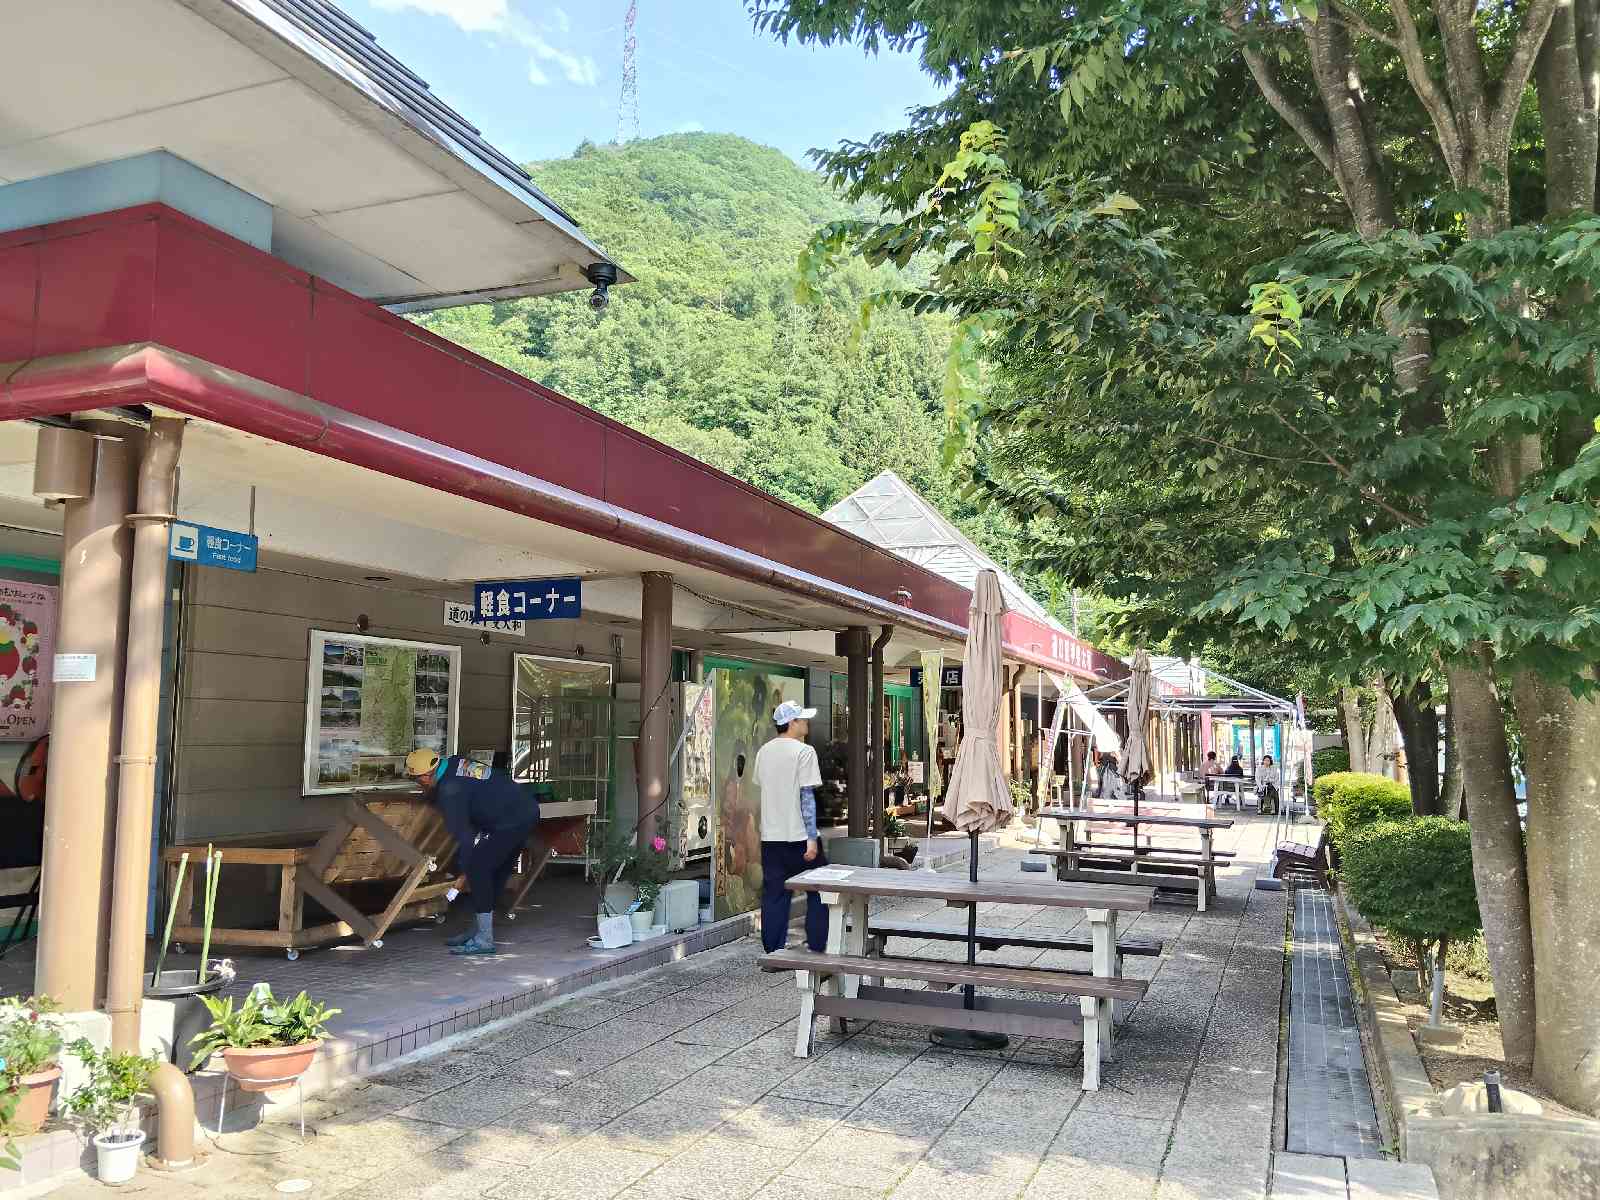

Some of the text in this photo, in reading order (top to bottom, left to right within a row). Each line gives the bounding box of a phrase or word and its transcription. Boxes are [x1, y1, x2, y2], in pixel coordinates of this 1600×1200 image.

[480, 587, 576, 617] 軽食コーナー
